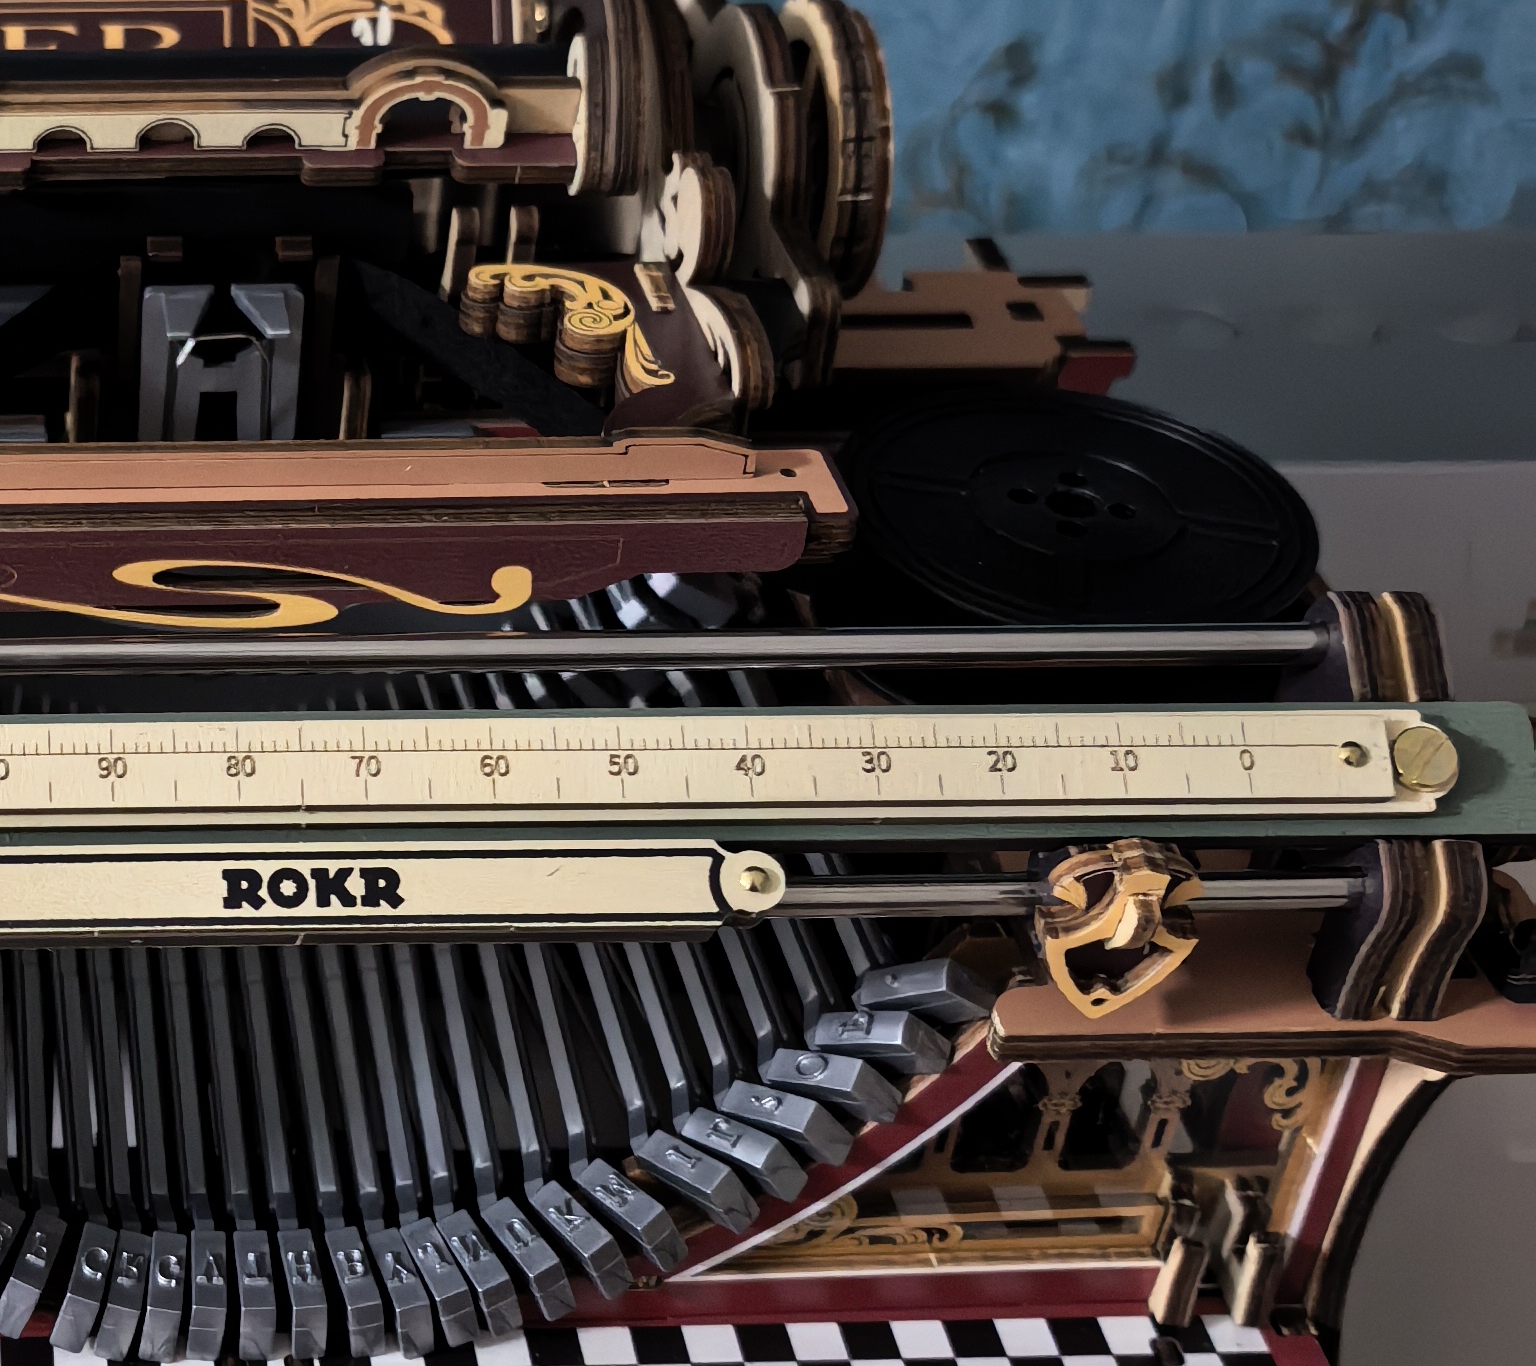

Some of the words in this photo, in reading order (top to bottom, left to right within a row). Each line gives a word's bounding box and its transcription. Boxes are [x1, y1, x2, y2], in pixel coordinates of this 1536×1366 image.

[97, 756, 128, 779] 90
[226, 751, 259, 778] 80
[349, 755, 382, 778] 70
[480, 754, 510, 778] 60
[608, 753, 639, 777] 50
[734, 753, 766, 777] 40
[860, 750, 894, 774] 30
[986, 749, 1018, 774] 20
[1109, 749, 1140, 773] 10
[1238, 748, 1255, 771] 0
[221, 866, 406, 911] ROKR
